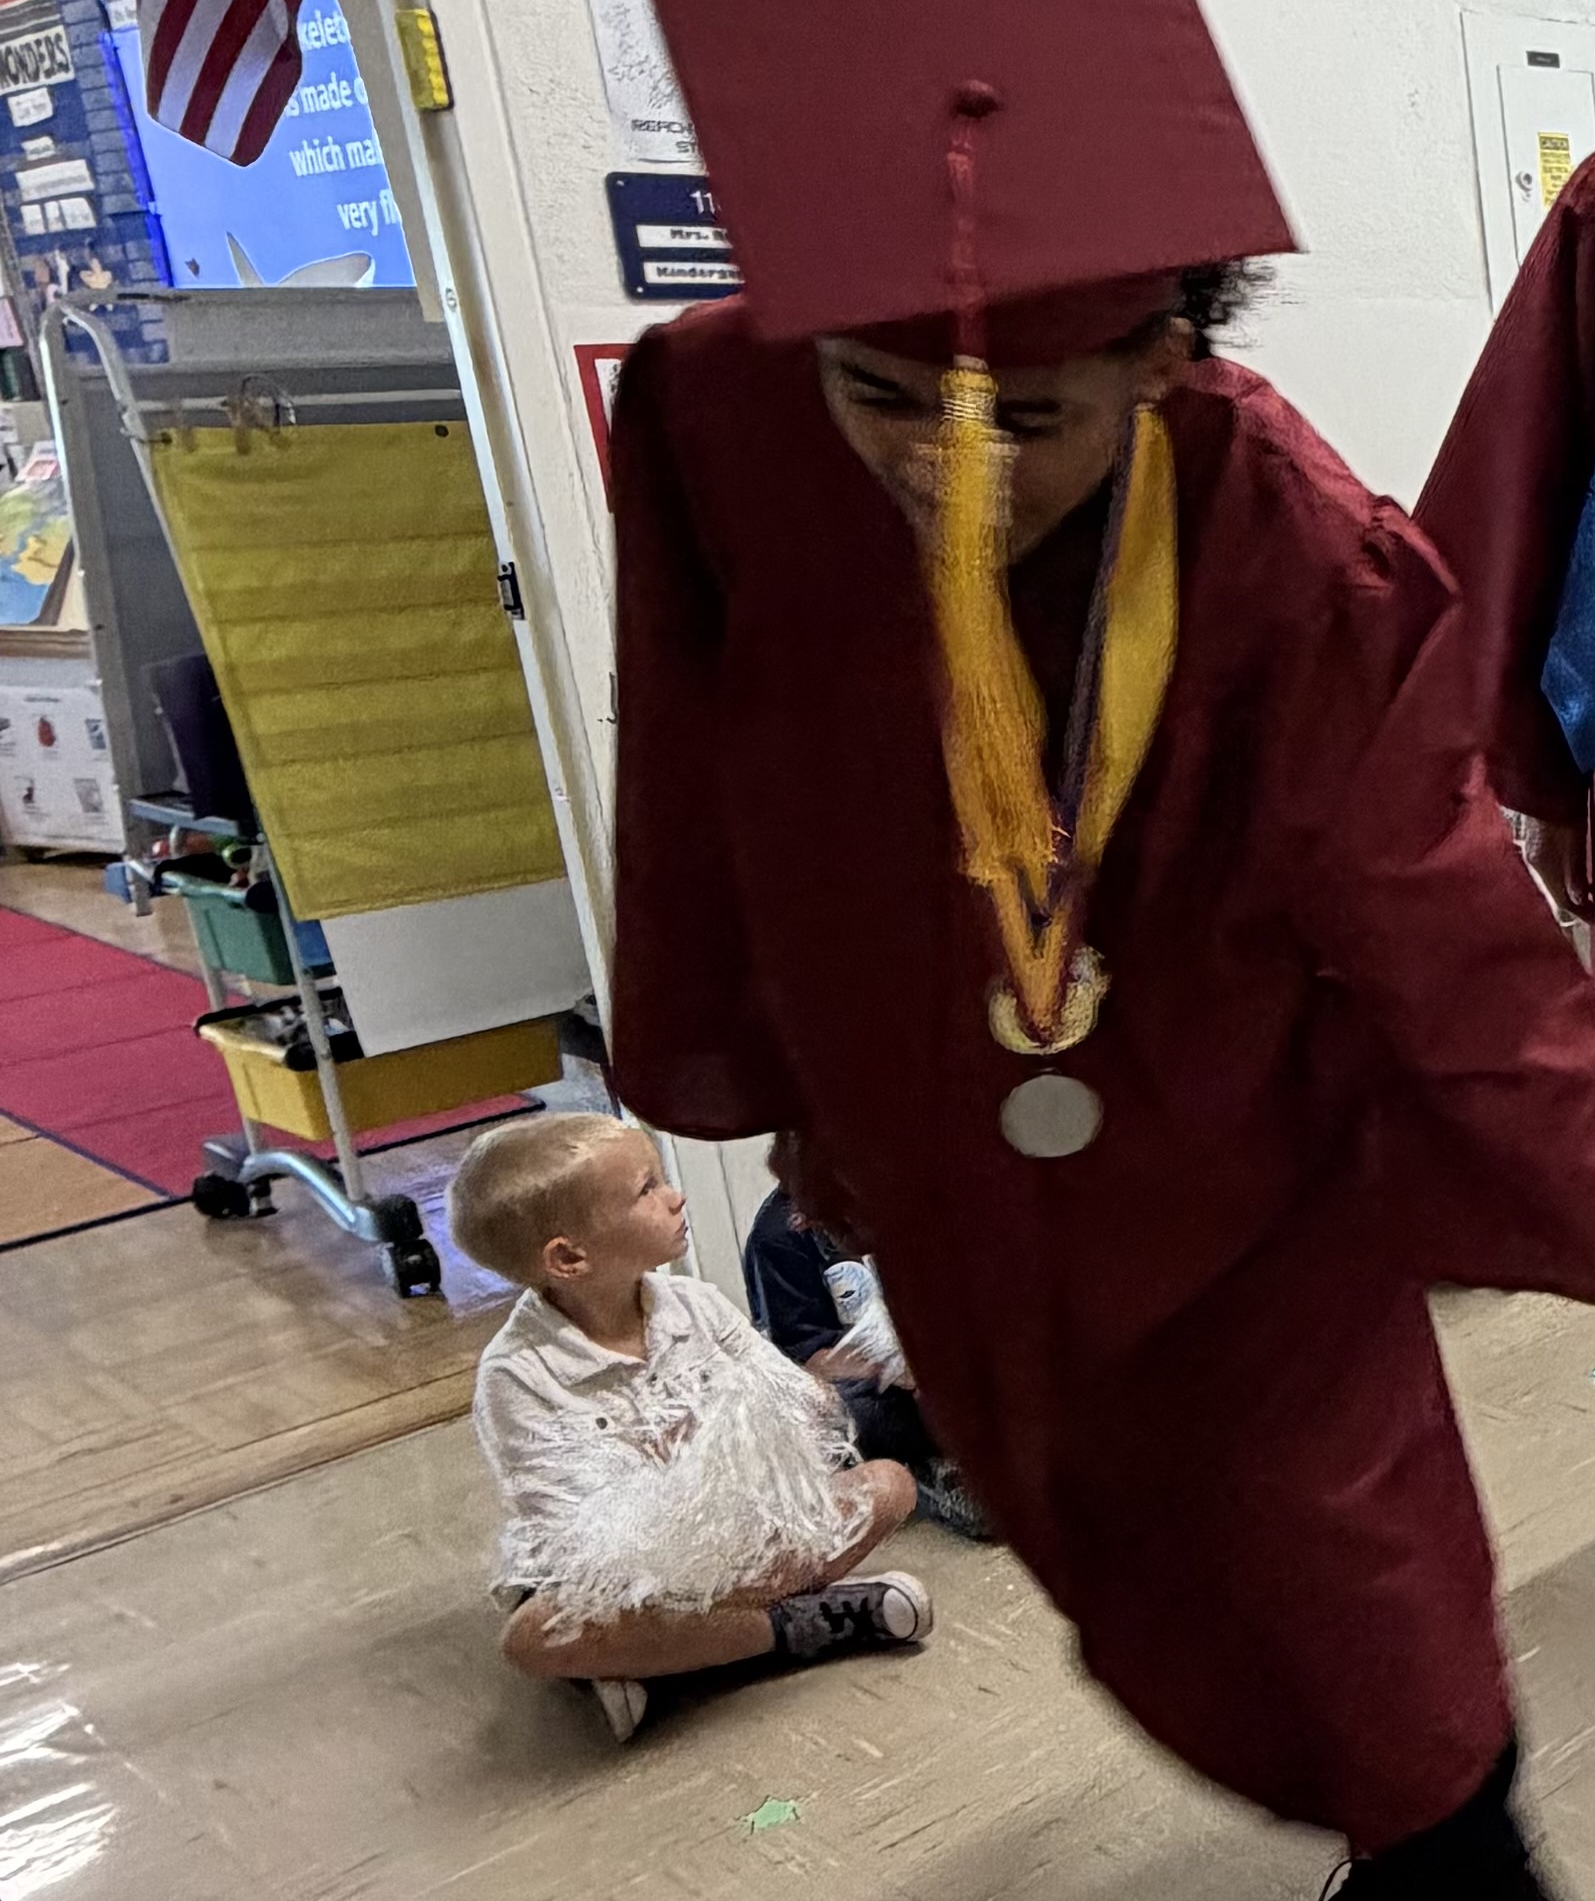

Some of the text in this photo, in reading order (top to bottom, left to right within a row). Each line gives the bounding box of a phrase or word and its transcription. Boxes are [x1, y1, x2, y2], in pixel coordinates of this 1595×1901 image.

[300, 71, 353, 113] made
[289, 135, 346, 177] which
[336, 200, 379, 237] very
[690, 190, 721, 214] 11
